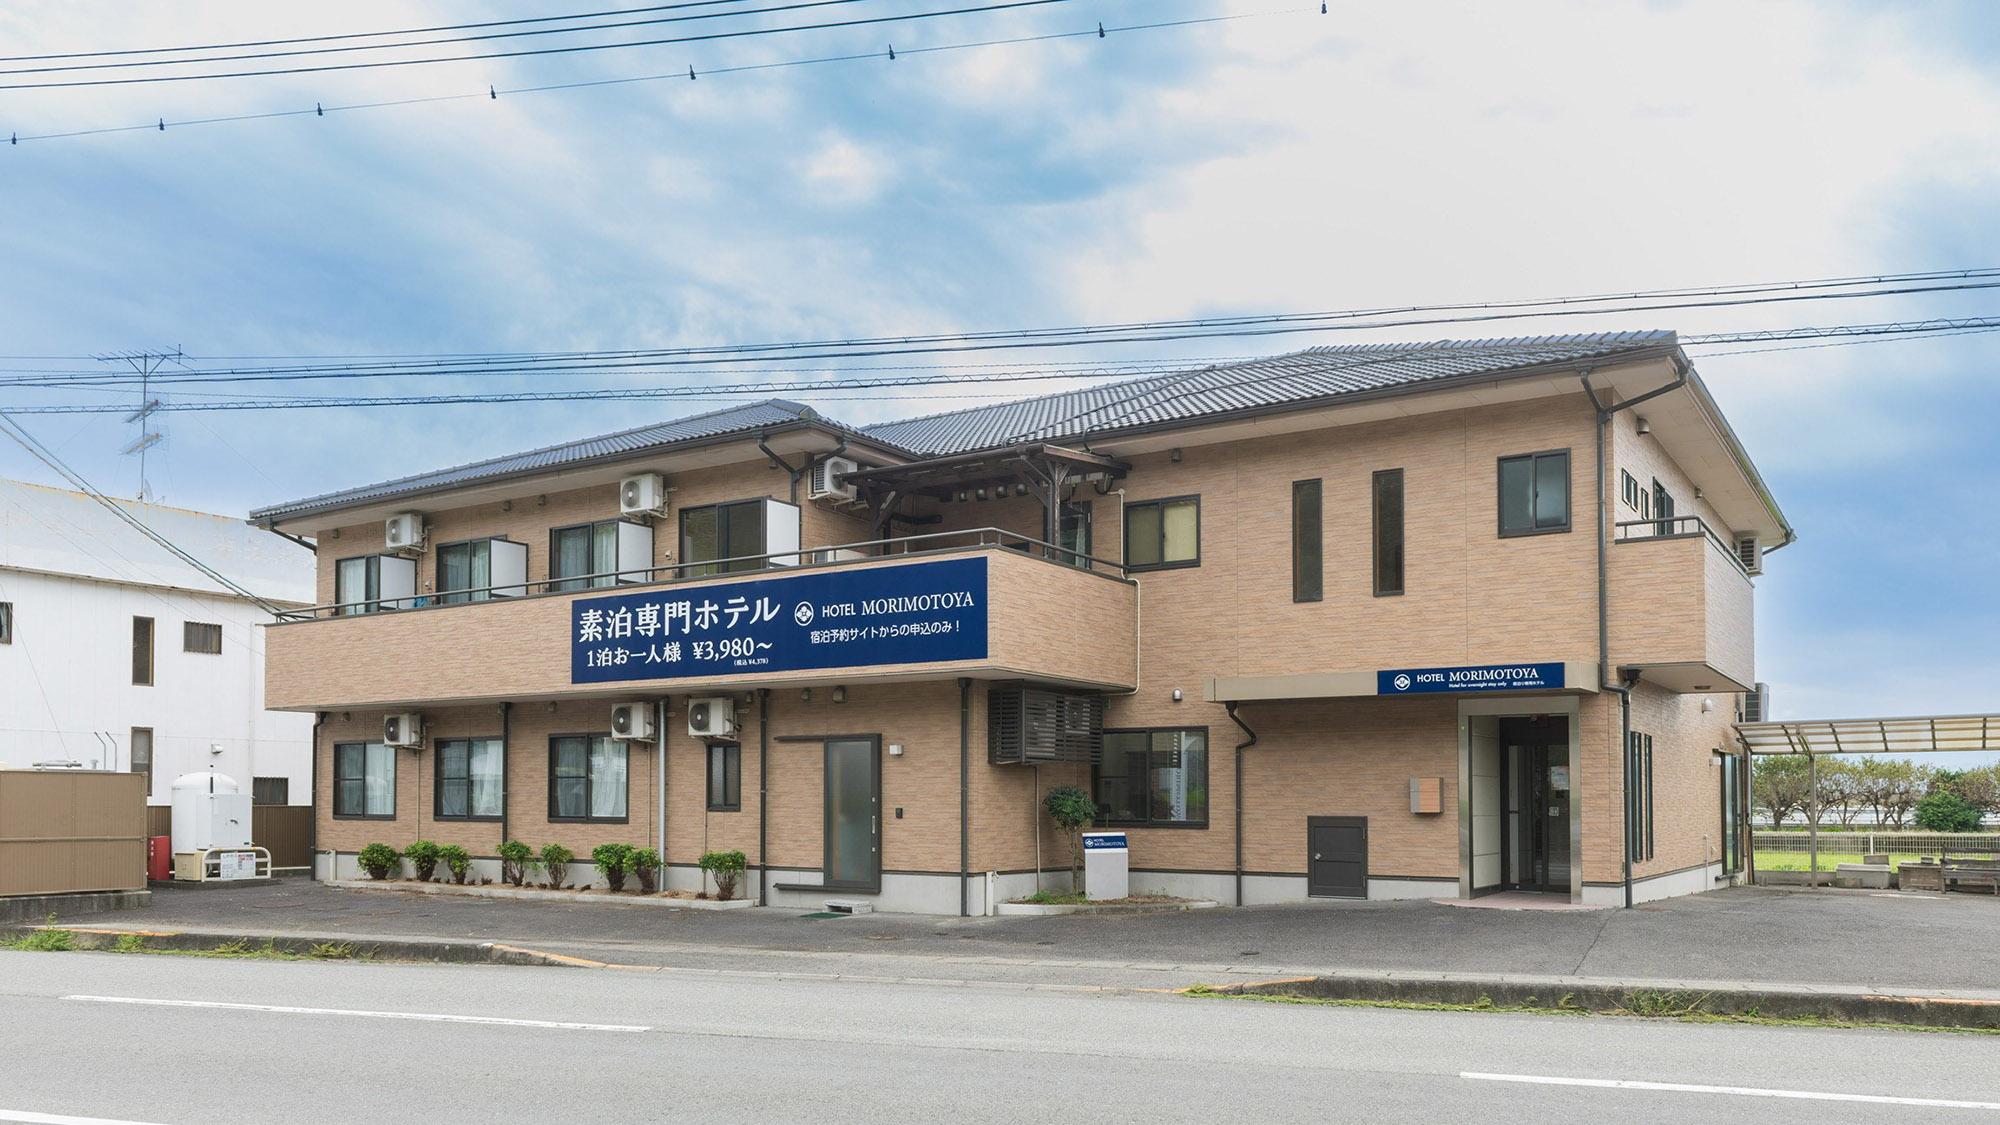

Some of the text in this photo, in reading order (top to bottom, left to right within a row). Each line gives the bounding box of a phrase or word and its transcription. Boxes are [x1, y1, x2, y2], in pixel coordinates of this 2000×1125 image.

[822, 591, 975, 618] HOTEL MORIMOTOYA
[578, 596, 781, 643] 素泊専門ホテル
[587, 641, 682, 667] 1泊お一人様
[1417, 668, 1539, 683] HOTEL MORIMOTOYA
